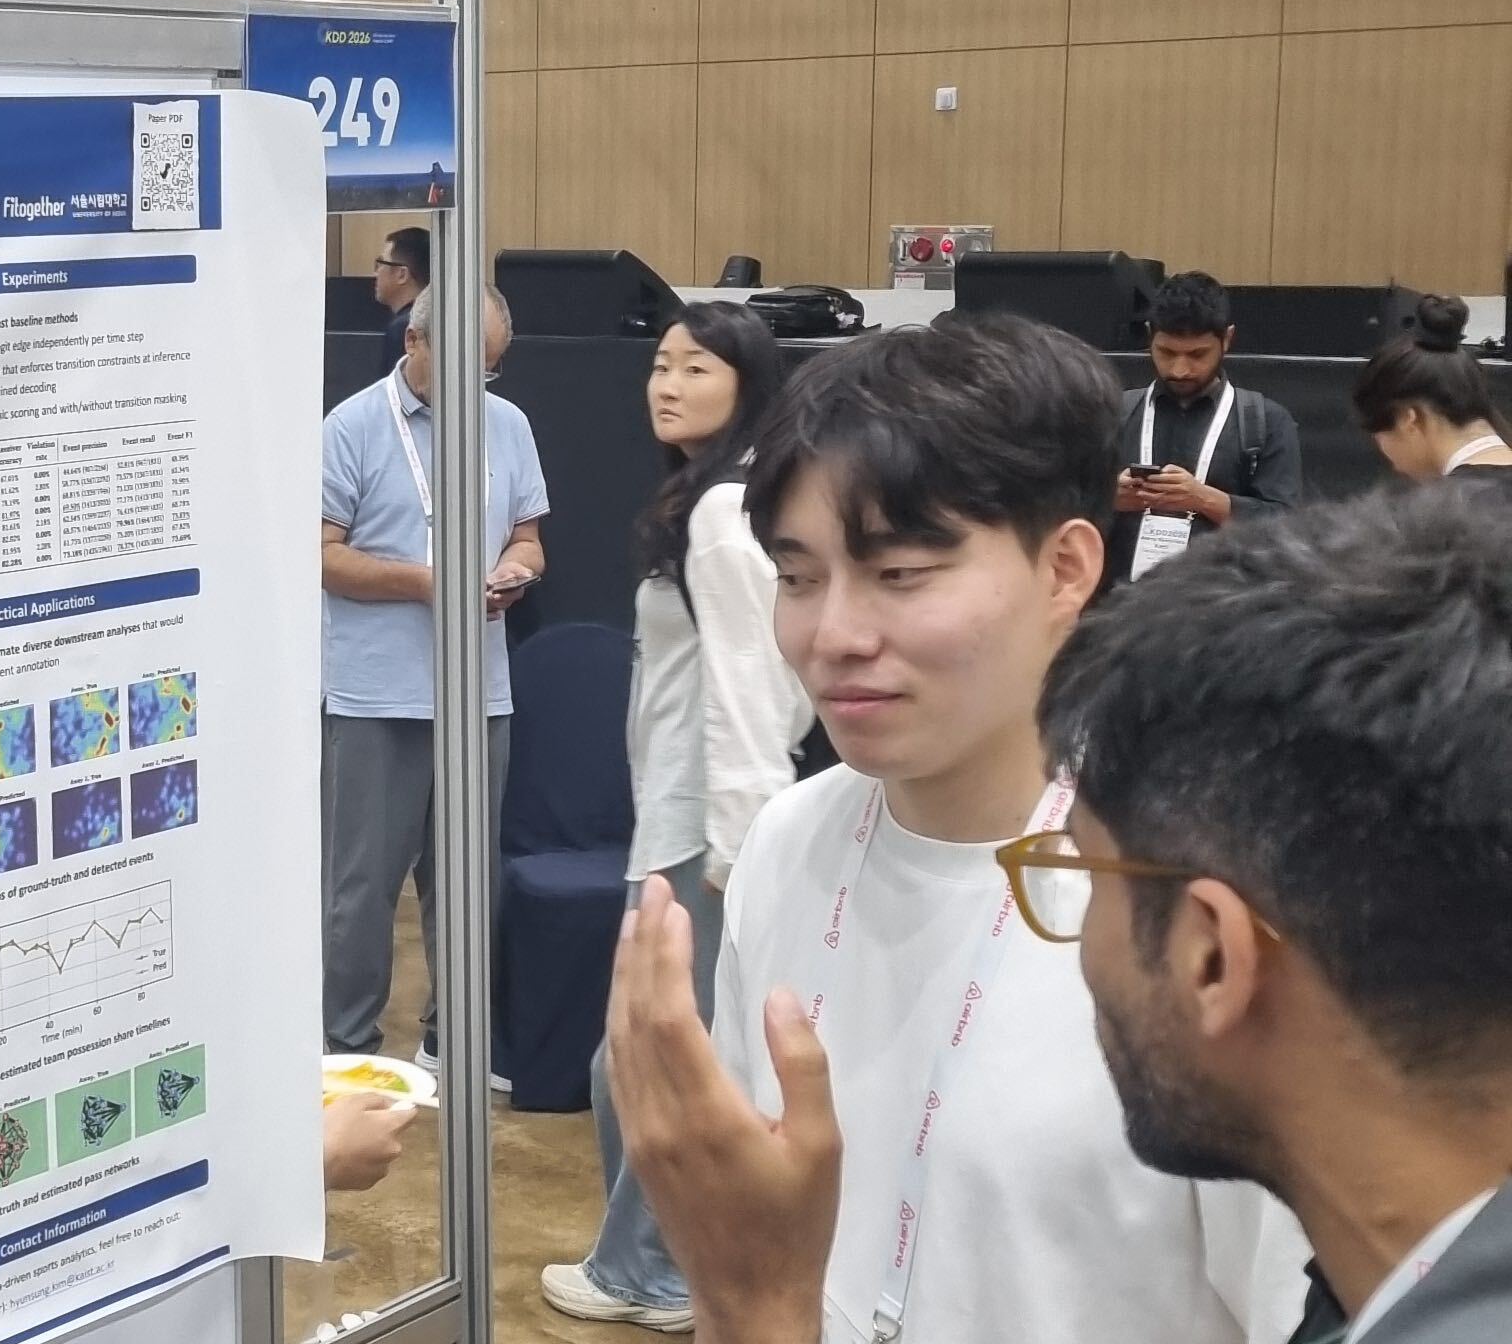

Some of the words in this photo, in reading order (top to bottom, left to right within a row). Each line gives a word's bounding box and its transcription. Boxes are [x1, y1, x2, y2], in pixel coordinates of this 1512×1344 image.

[325, 31, 347, 44] KDD
[348, 31, 371, 44] 2026
[169, 114, 184, 124] PDF
[308, 76, 401, 147] 249
[4, 196, 66, 221] Fitogether
[1, 270, 68, 289] Experiments
[10, 314, 43, 328] baseline
[44, 311, 78, 324] methods
[30, 595, 95, 617] Applications
[22, 640, 52, 653] diverse
[53, 630, 104, 647] downstream
[106, 623, 140, 637] analyses
[142, 619, 157, 630] that
[159, 614, 183, 627] would
[7, 885, 17, 898] of
[18, 871, 72, 898] ground-truth
[73, 866, 89, 880] and
[90, 857, 127, 876] detected
[128, 852, 154, 866] events
[0, 1056, 42, 1080] estimated
[43, 1051, 65, 1066] team
[66, 1037, 111, 1060] possession
[113, 1029, 134, 1044] share
[135, 1017, 170, 1035] timelines
[41, 1033, 60, 1045] Time
[22, 1192, 39, 1207] and
[40, 1175, 82, 1200] estimated
[84, 1171, 102, 1187] pass
[104, 1156, 140, 1177] networks
[0, 1231, 42, 1257] Contact
[44, 1208, 106, 1241] Information
